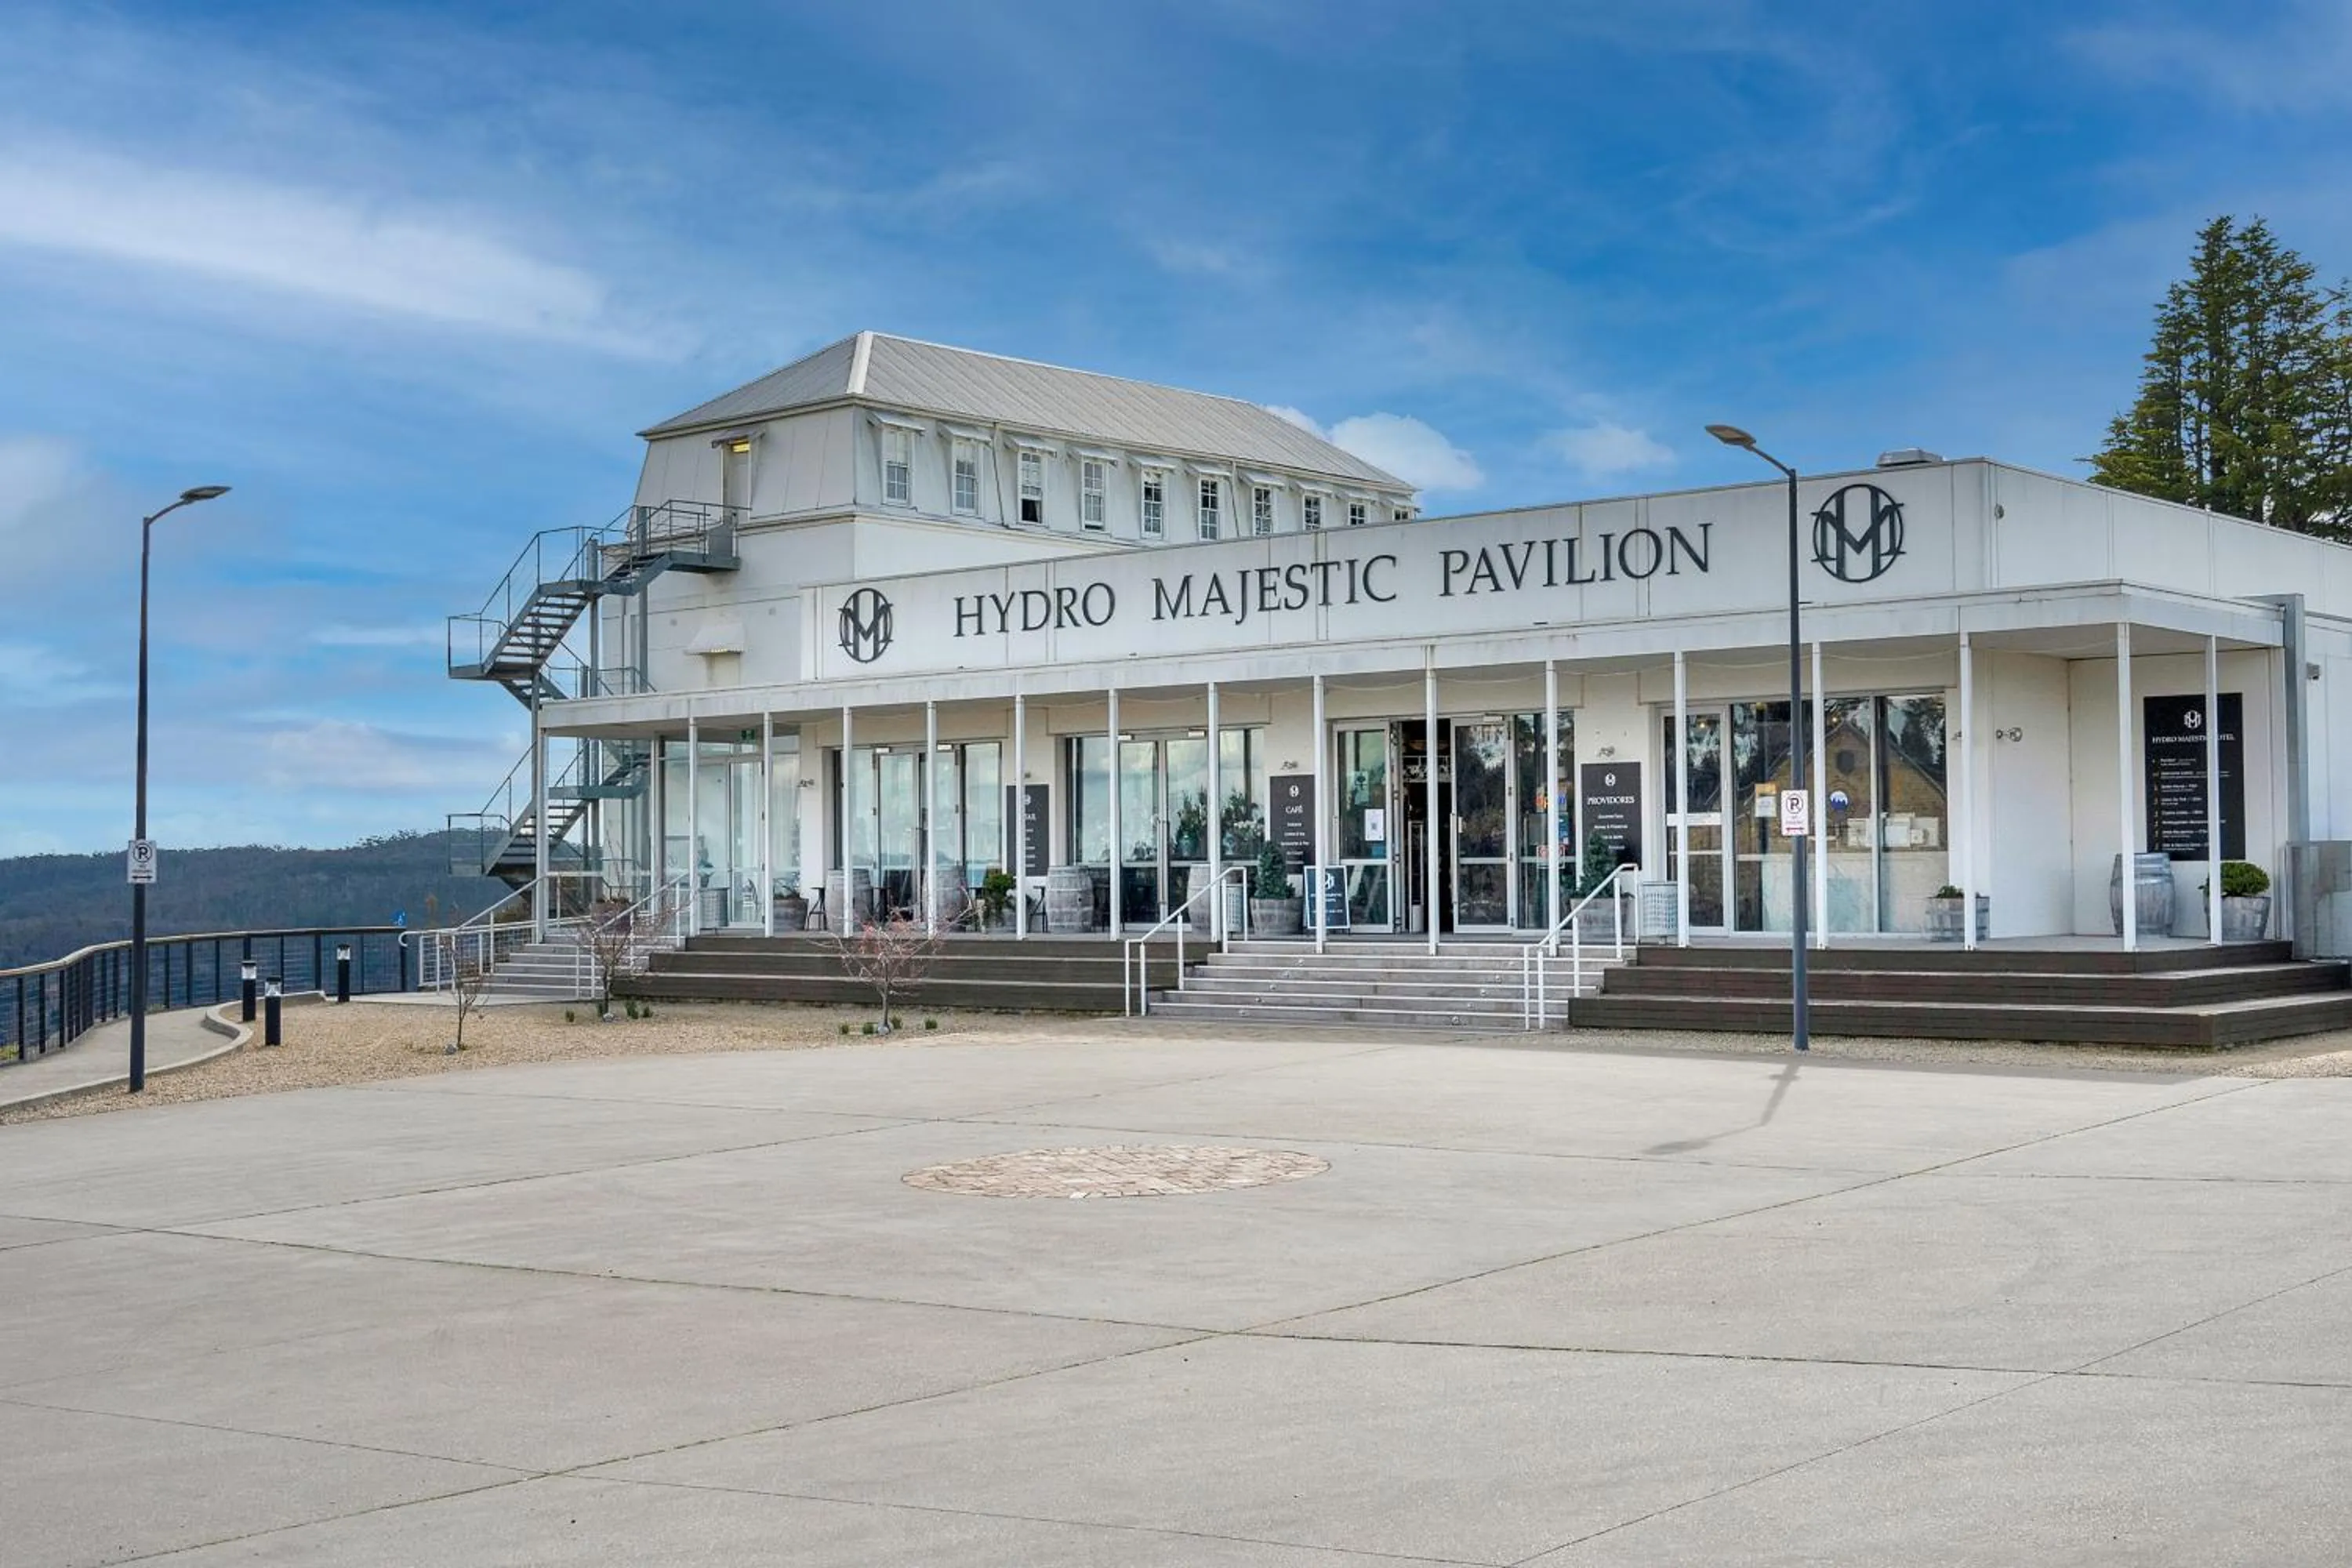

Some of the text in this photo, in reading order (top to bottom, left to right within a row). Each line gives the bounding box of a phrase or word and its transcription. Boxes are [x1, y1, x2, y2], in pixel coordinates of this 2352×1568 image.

[953, 522, 1713, 637] HYDRO MAJESTIC PAVILION
[1587, 796, 1635, 805] PROVIDORES
